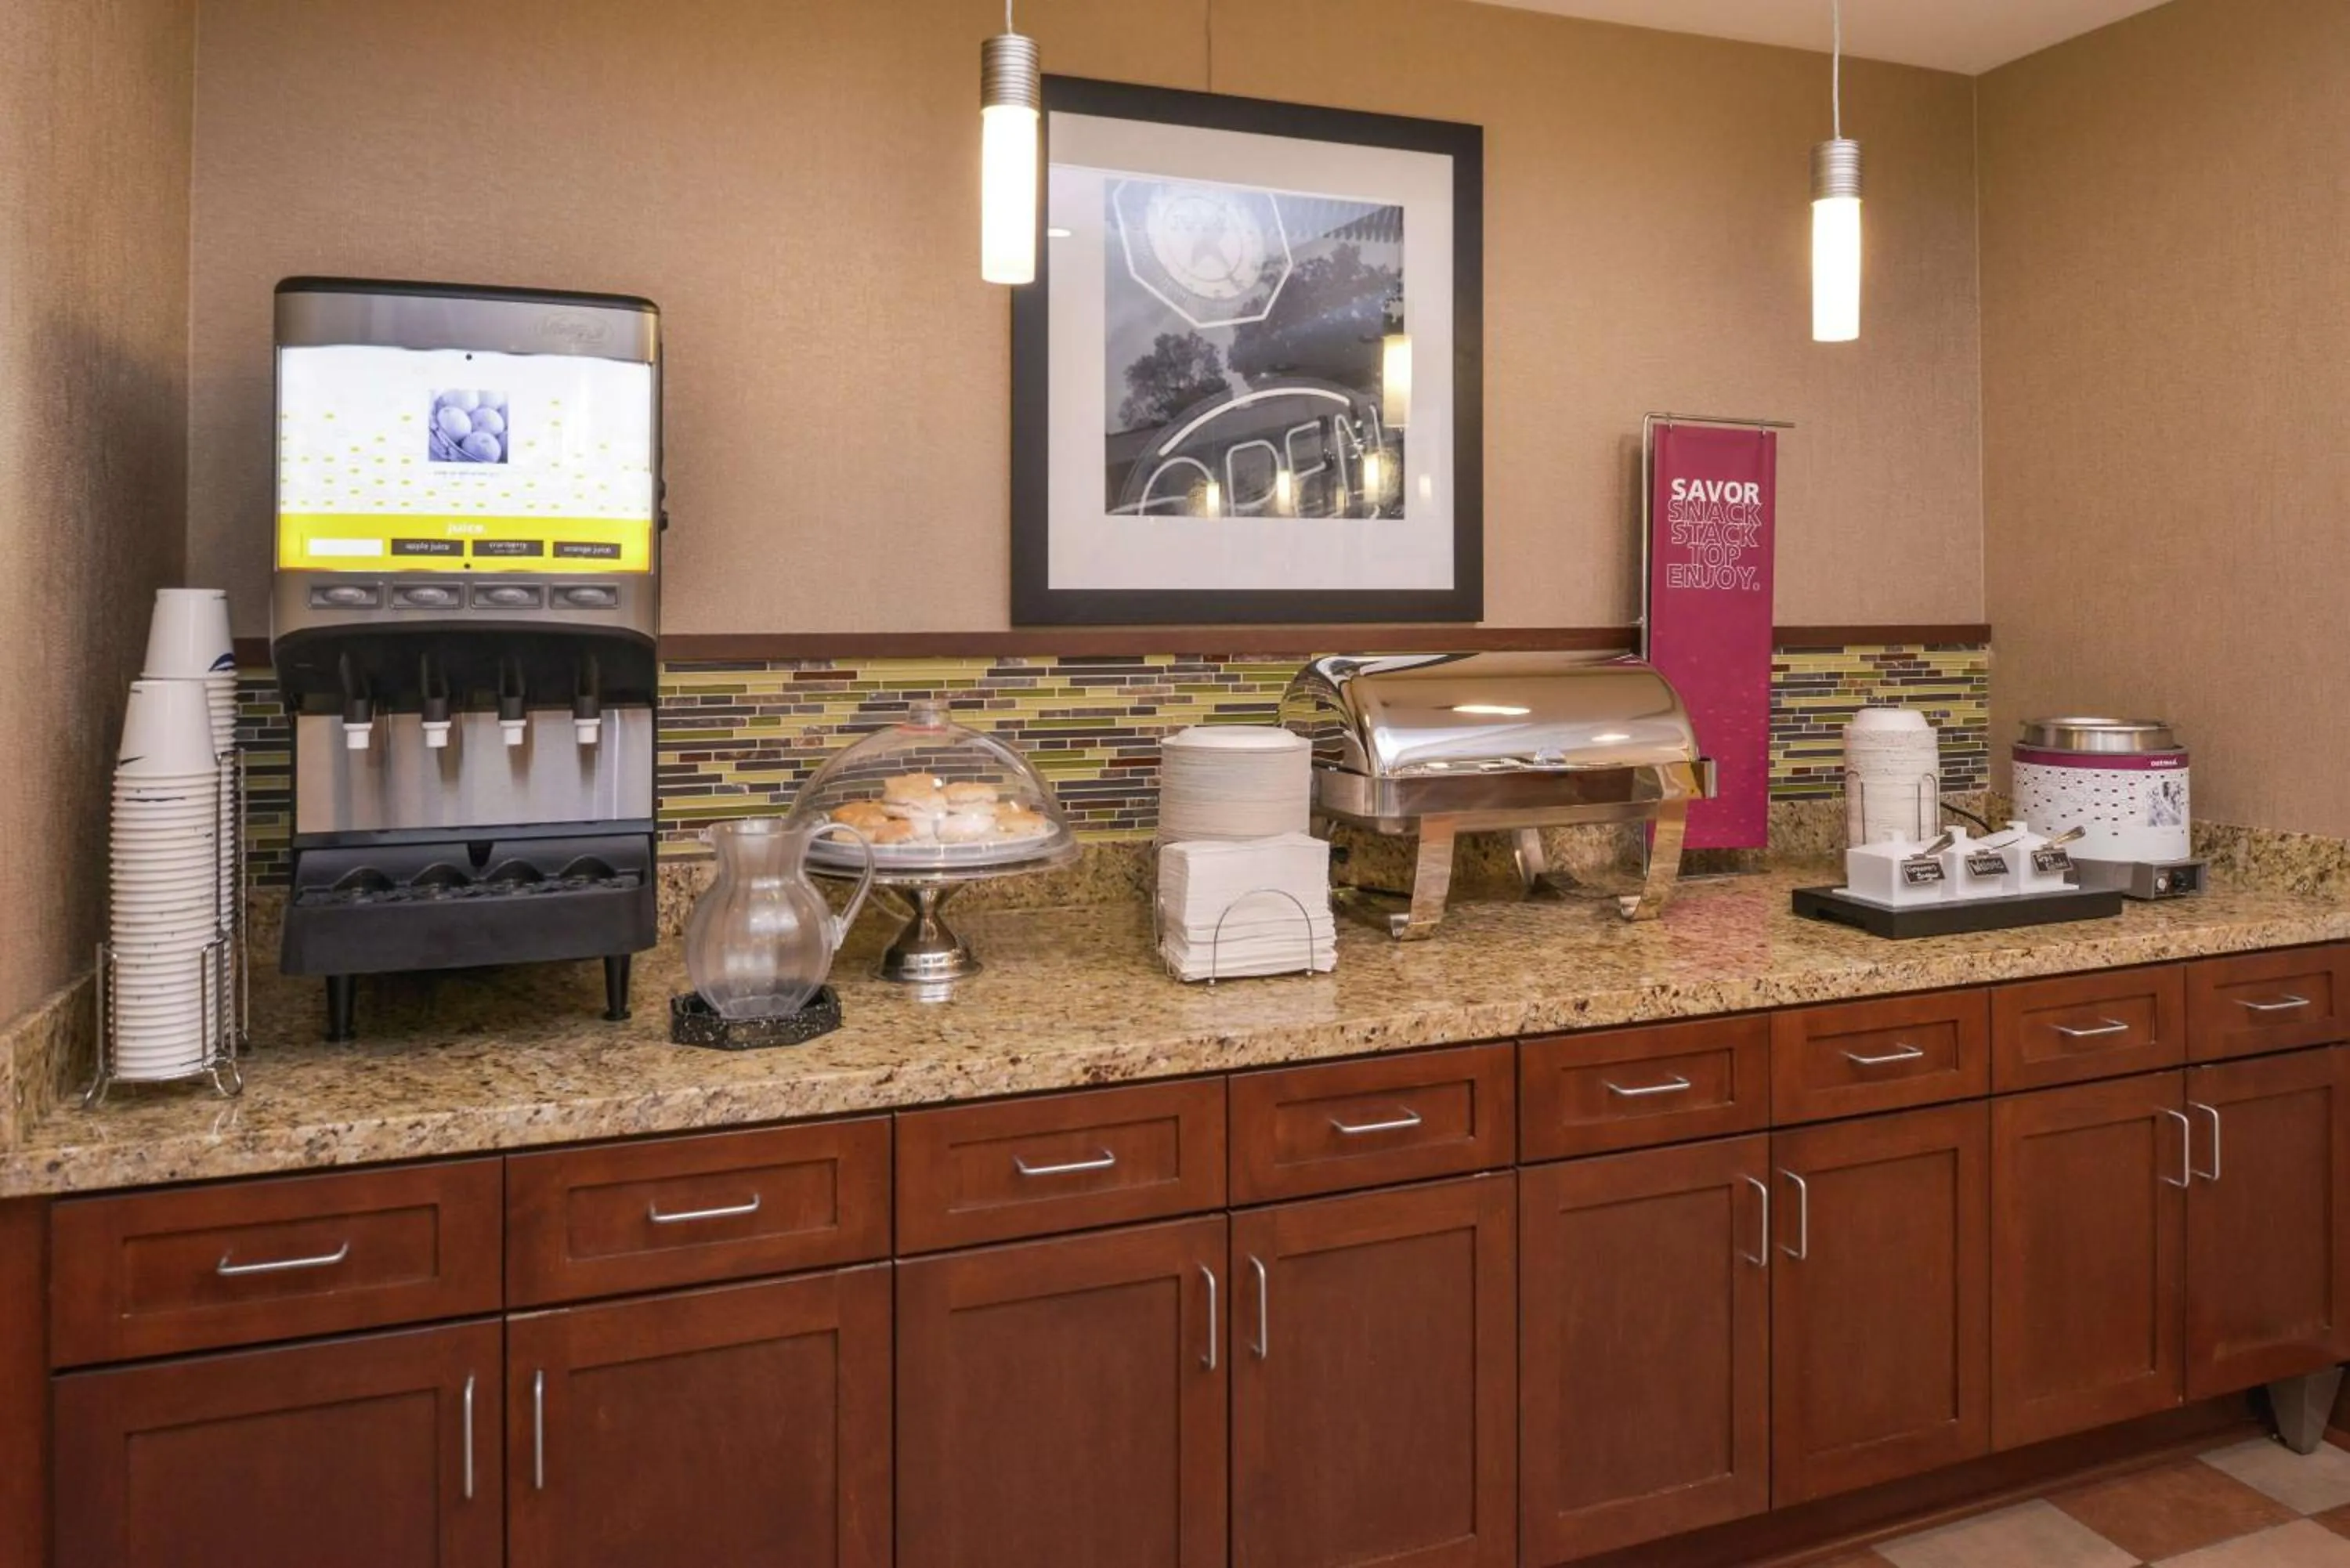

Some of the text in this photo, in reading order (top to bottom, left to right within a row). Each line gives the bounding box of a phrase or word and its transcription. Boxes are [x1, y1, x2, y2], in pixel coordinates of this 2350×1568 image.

[1671, 478, 1759, 504] SAVOR
[1668, 499, 1762, 526] SNACK
[405, 542, 450, 551] apple juice
[1671, 521, 1760, 547] STACK
[592, 545, 612, 555] juice
[1687, 542, 1741, 567] TOP
[1666, 563, 1760, 591] ENJOY.
